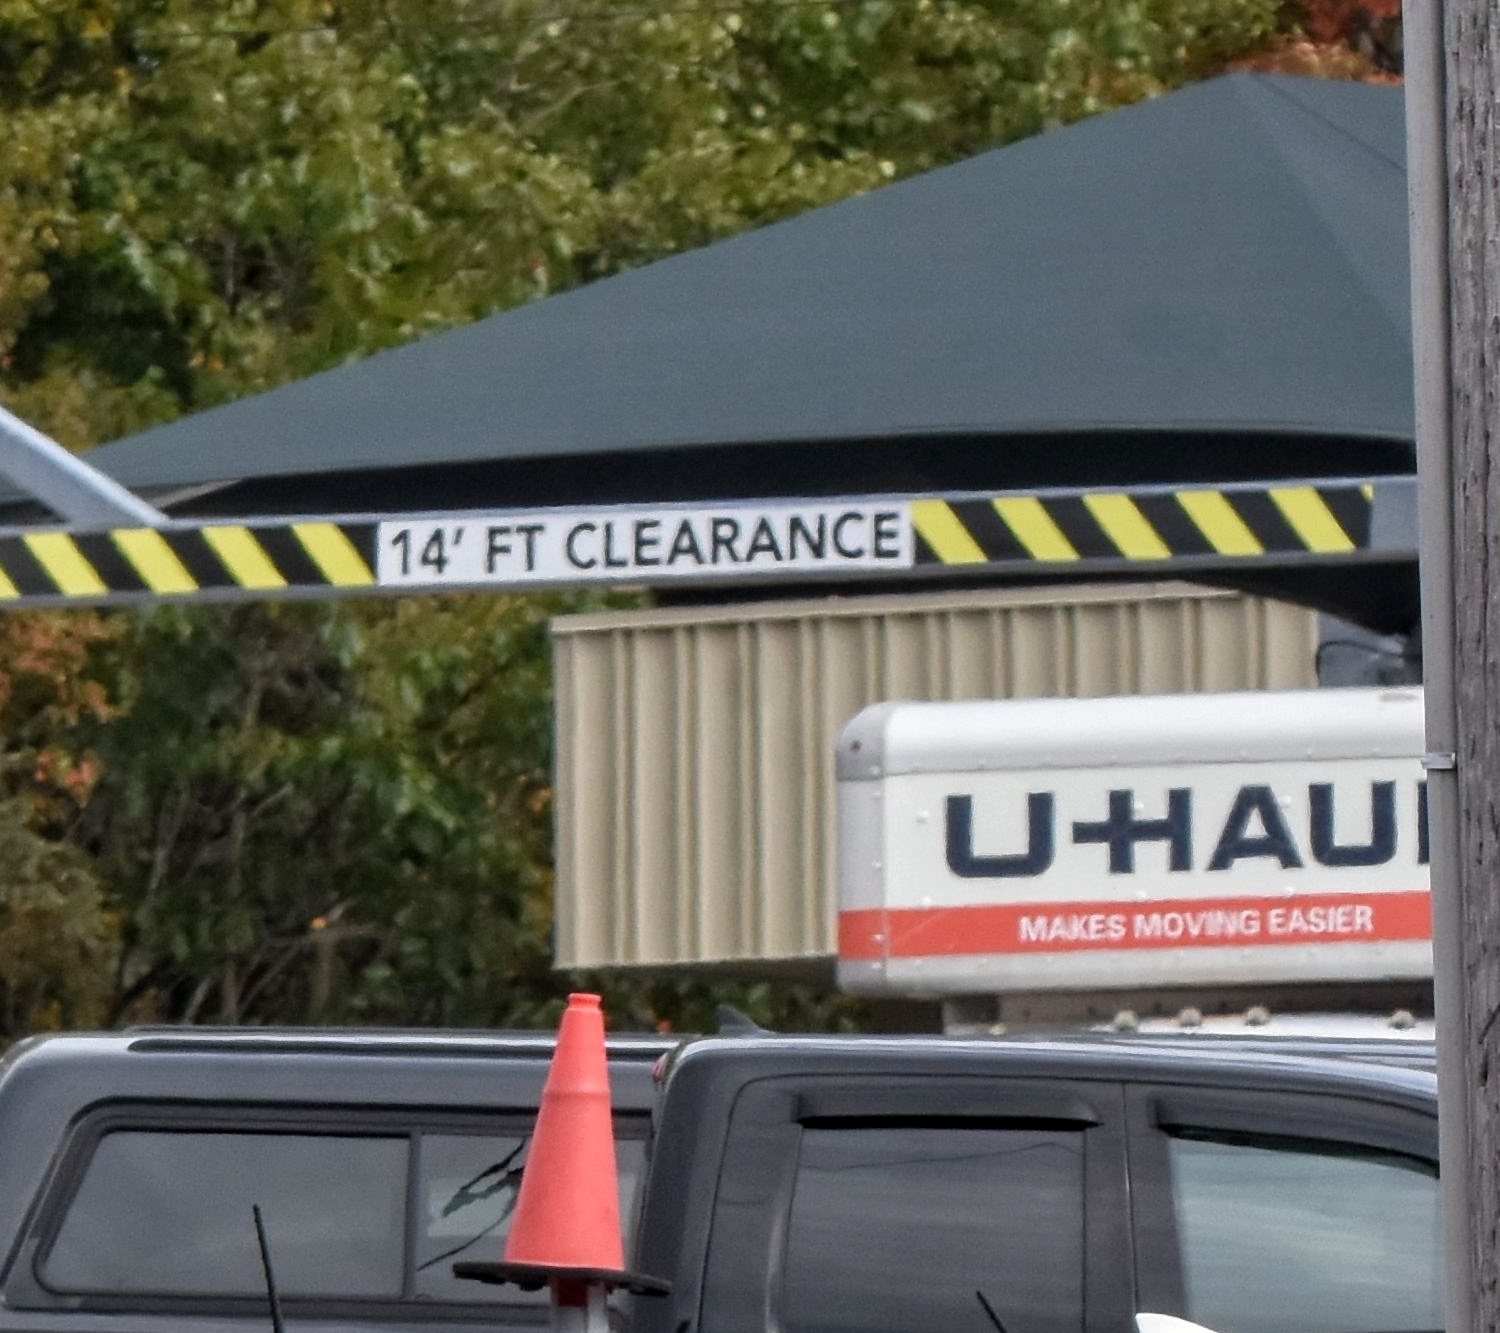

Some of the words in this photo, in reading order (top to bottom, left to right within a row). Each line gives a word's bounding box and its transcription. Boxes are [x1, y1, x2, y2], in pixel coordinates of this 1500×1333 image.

[390, 527, 464, 576] 14'
[485, 524, 546, 574] FT
[564, 511, 902, 569] CLEARANCE
[945, 779, 1430, 878] U-HAU
[1019, 913, 1127, 944] MAKES
[1132, 909, 1261, 939] MOVING
[1267, 904, 1374, 935] EASIER
